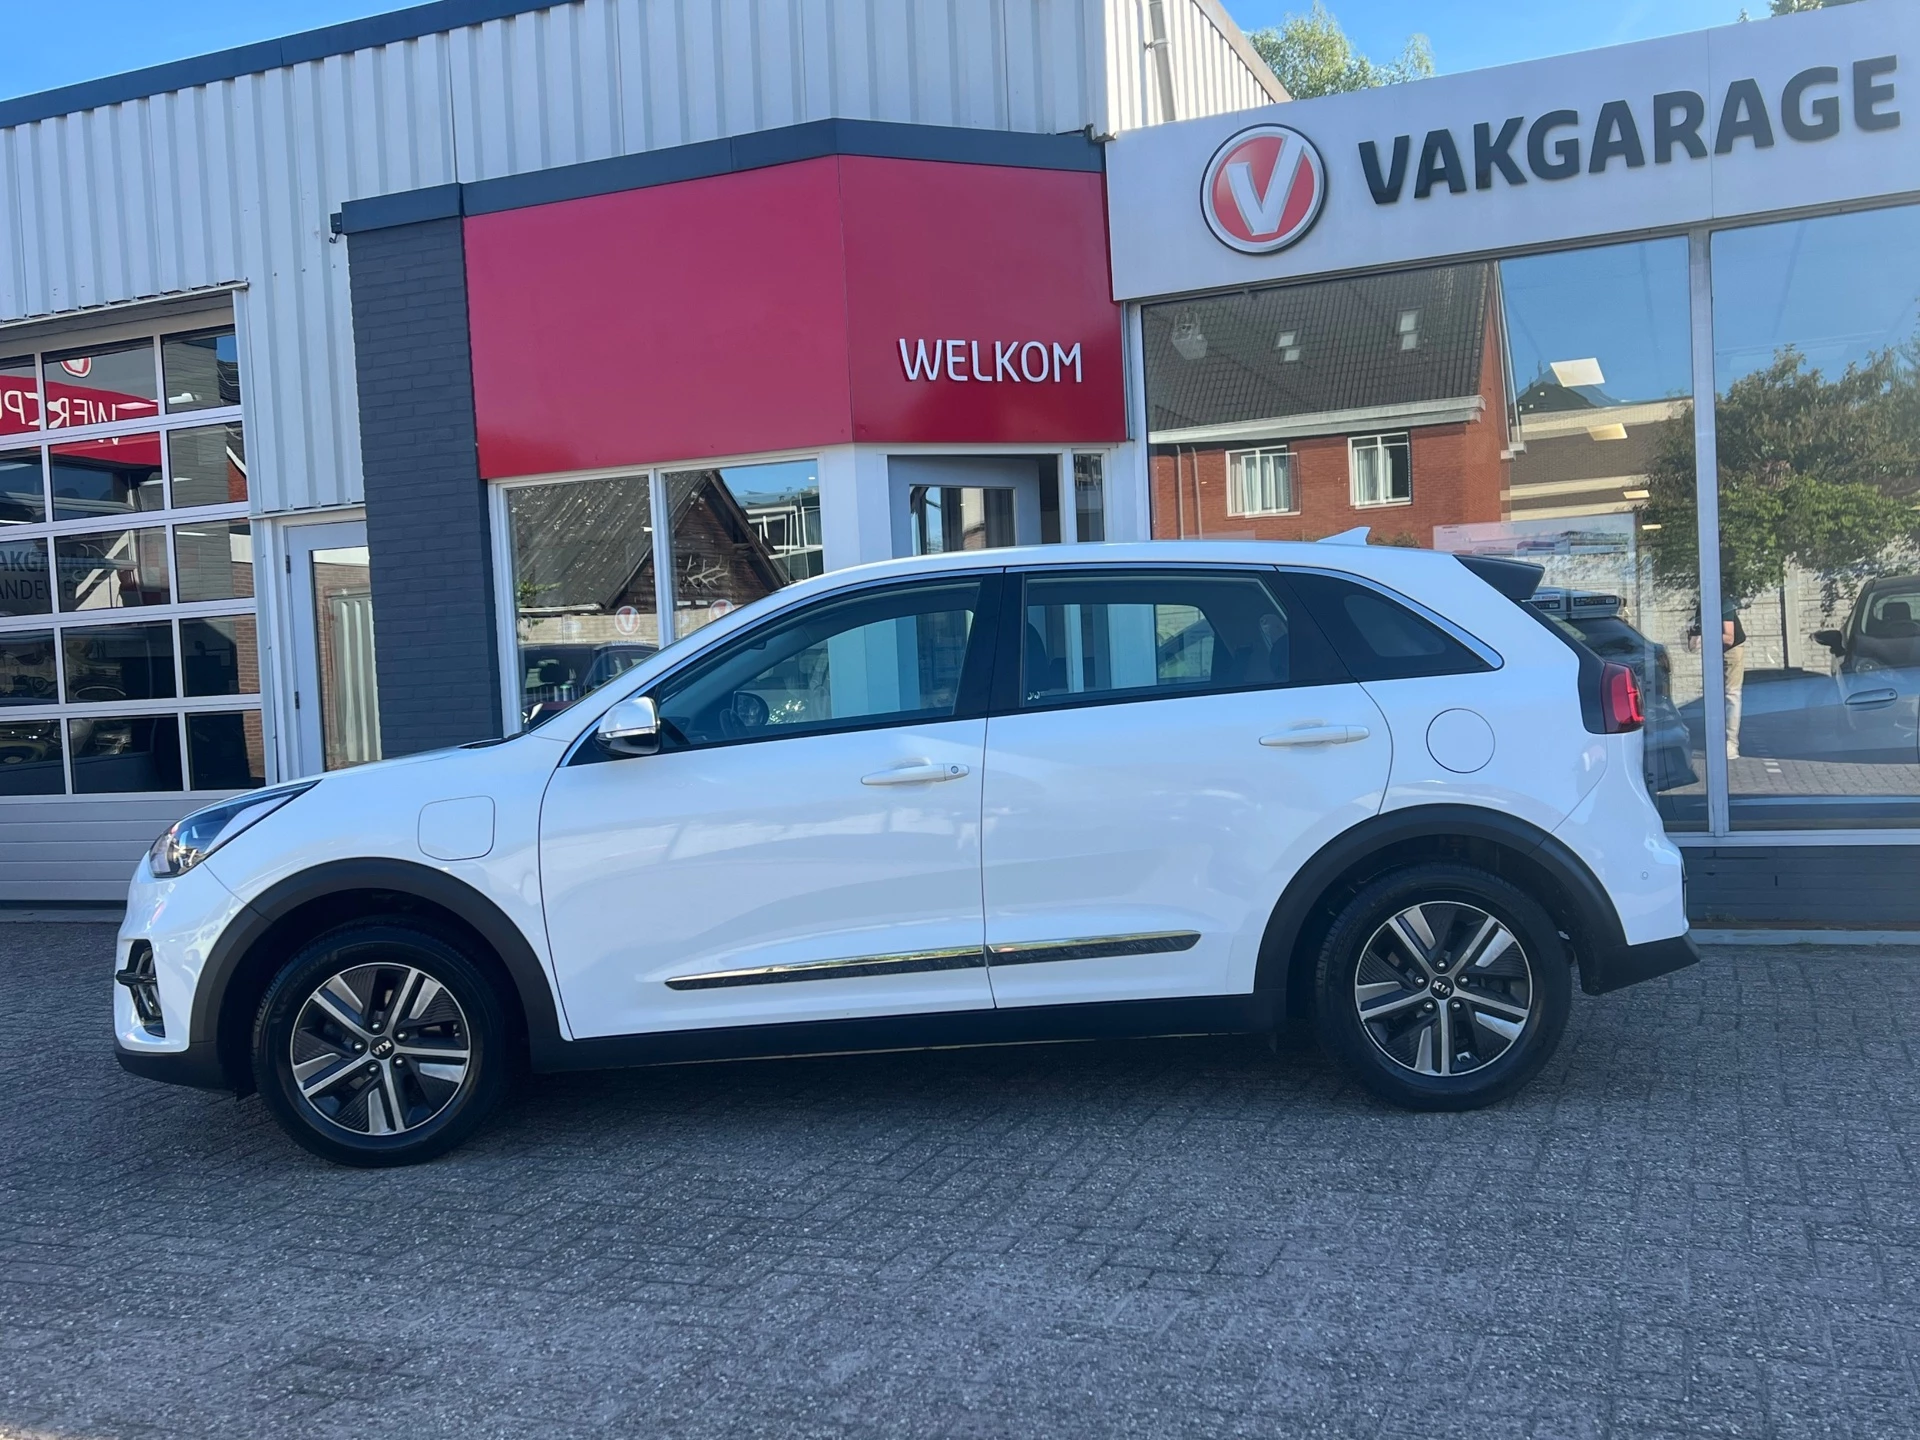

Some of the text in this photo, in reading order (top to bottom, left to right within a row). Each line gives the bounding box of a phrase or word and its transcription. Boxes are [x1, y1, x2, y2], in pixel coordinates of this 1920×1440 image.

[1358, 54, 1901, 206] VAKGARAGE
[898, 338, 1083, 383] WELKOM
[1432, 980, 1451, 996] KIA
[372, 1040, 392, 1056] KIA
